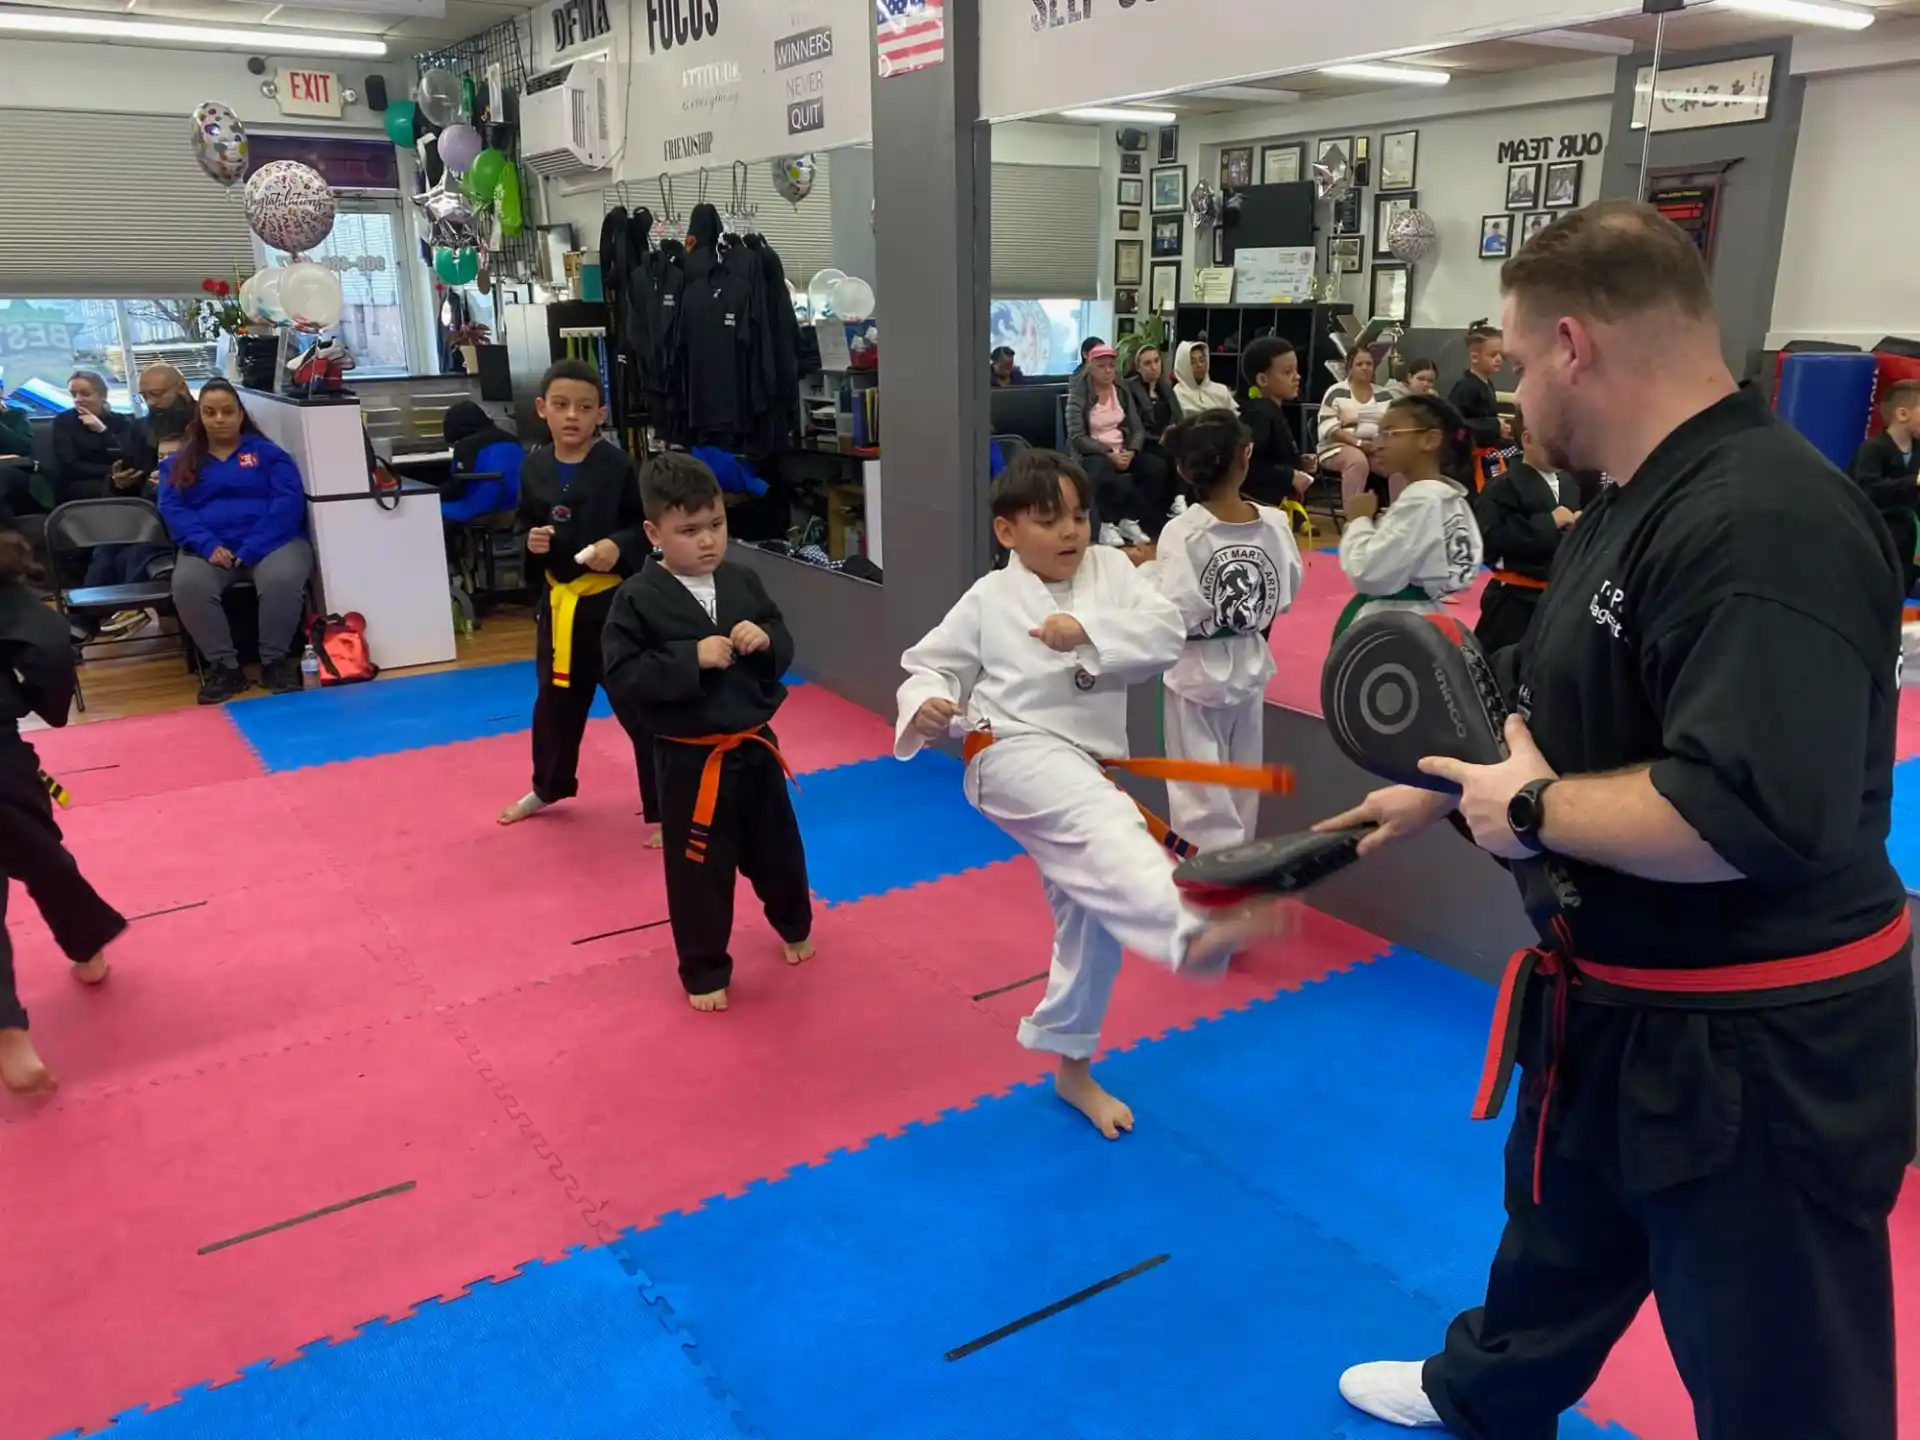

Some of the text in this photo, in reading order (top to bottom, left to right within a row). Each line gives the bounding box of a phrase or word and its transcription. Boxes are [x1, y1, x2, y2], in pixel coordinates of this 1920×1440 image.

[551, 0, 611, 52] DFMA
[646, 0, 719, 55] FOCUS
[775, 31, 831, 66] WINNERS
[290, 72, 330, 103] EXIT
[786, 70, 824, 98] NEVER
[791, 103, 820, 130] QUIT
[663, 131, 713, 162] FRIENDSHIP
[1203, 551, 1229, 600] RAGOFIT
[1265, 571, 1276, 600] ARTS
